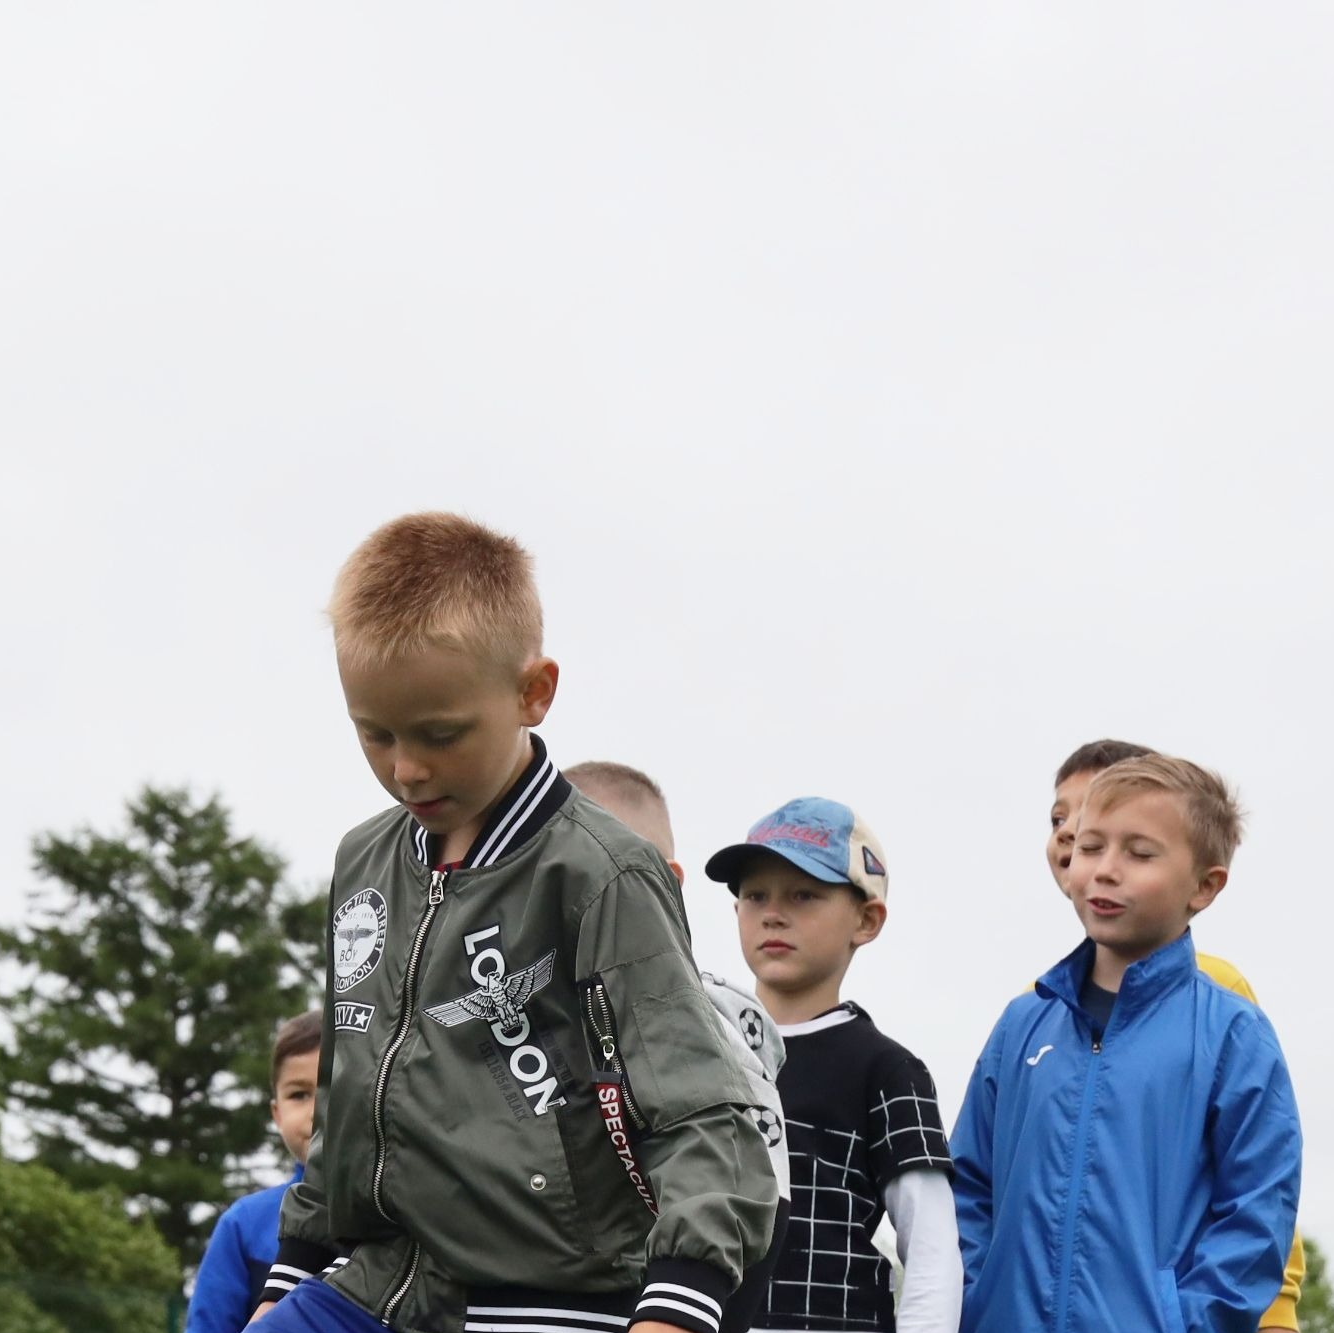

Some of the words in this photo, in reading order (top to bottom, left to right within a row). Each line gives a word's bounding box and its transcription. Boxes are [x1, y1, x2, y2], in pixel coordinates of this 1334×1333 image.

[376, 904, 386, 954] STREET
[336, 962, 372, 990] LONDON
[464, 925, 567, 1116] LODON
